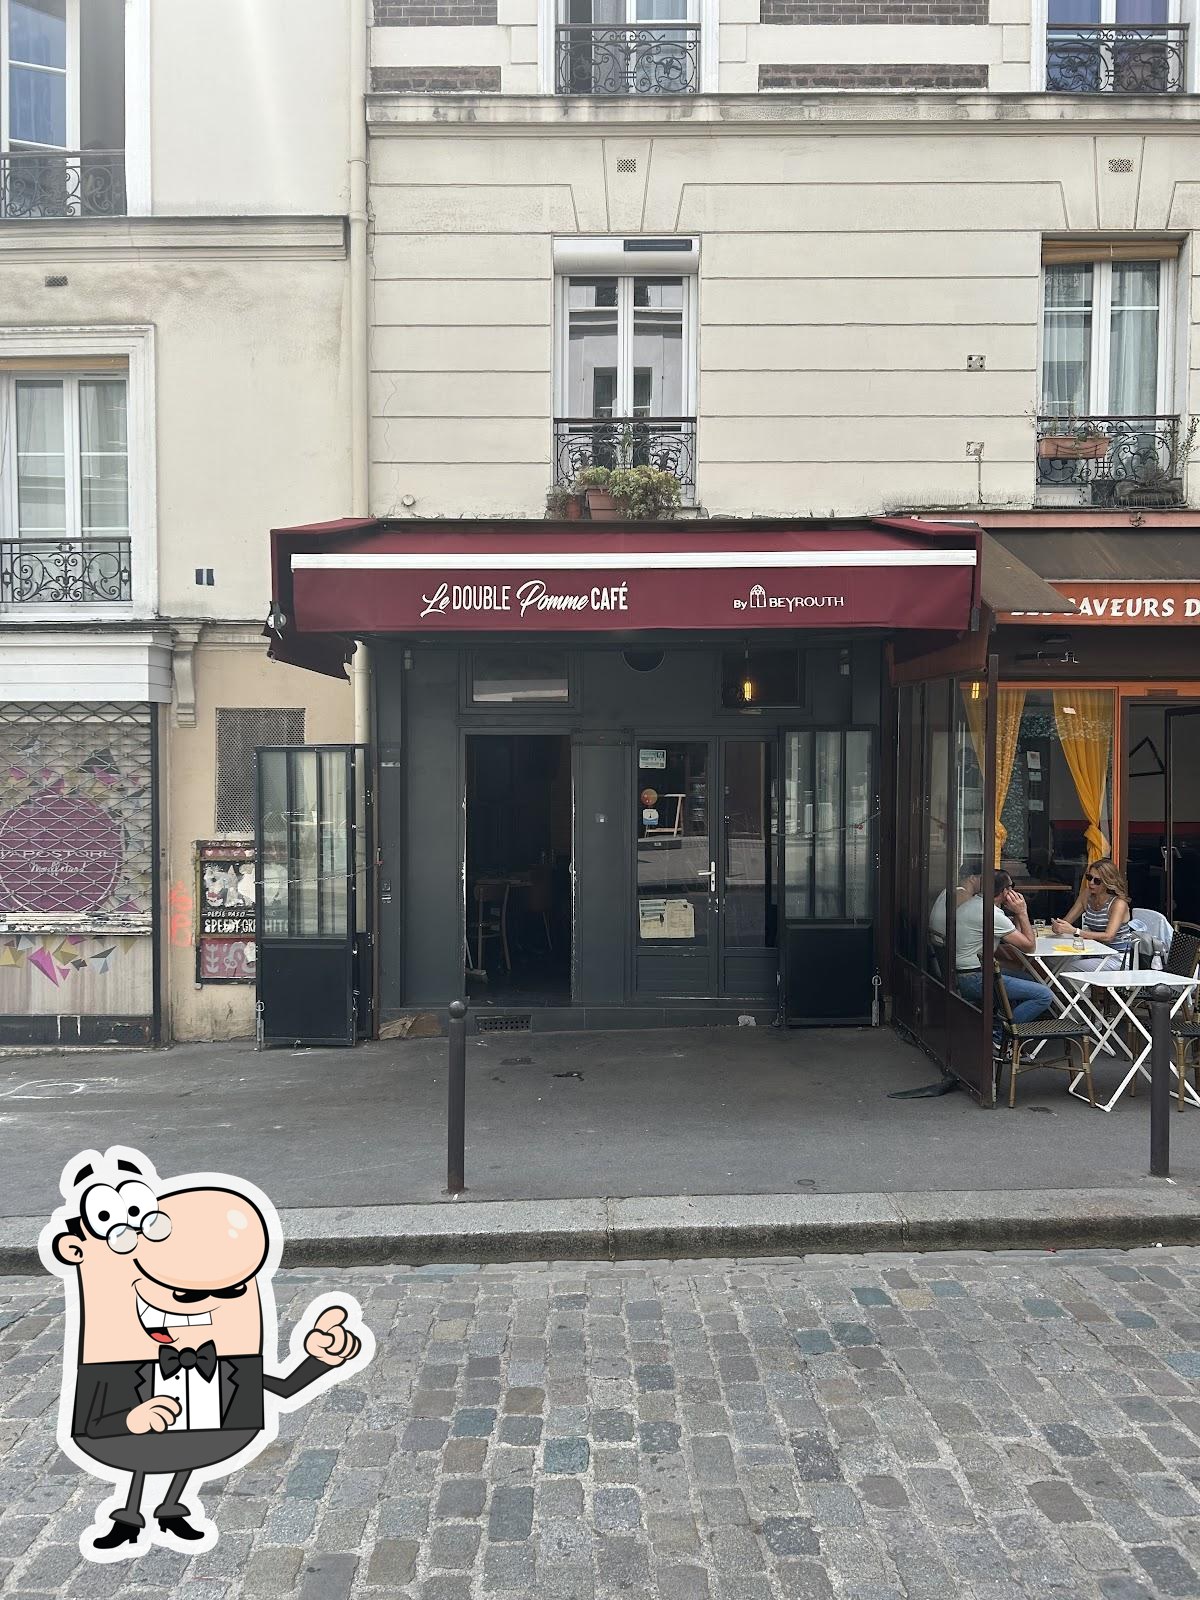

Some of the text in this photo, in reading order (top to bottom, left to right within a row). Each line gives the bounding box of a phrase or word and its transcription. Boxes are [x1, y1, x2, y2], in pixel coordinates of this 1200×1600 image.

[420, 580, 629, 618] Le DOUBLE Pomme CAFÉ
[733, 596, 844, 612] By BEYROUTH
